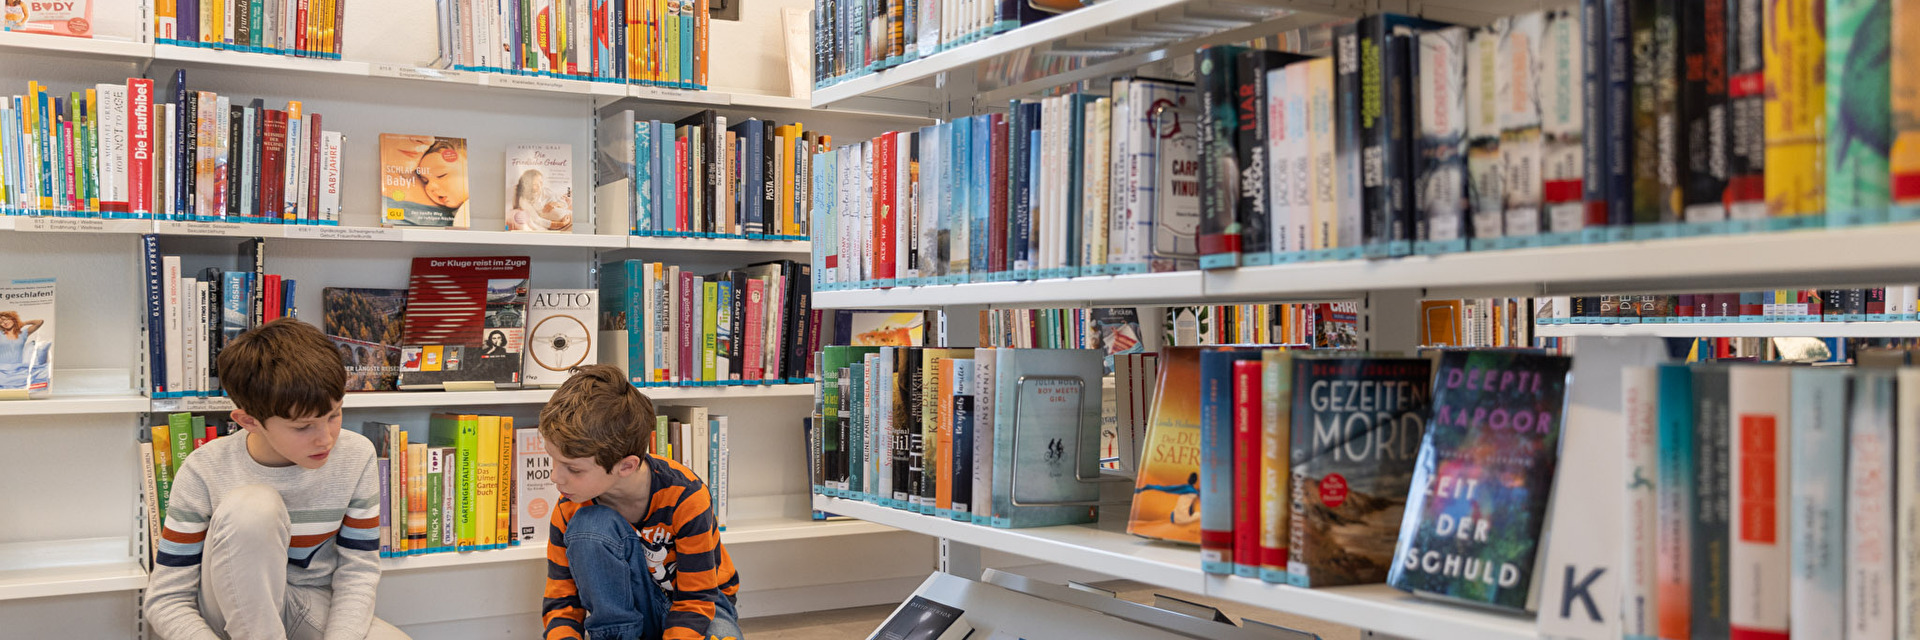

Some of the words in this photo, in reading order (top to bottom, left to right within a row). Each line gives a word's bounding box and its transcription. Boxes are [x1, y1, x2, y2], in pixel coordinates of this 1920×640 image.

[134, 83, 147, 139] Laufbibel
[1240, 84, 1256, 131] LIAR
[114, 128, 123, 150] NOT
[134, 141, 147, 160] Die
[386, 174, 416, 188] Baby!
[1172, 160, 1199, 176] CARP
[1242, 167, 1253, 197] LISA
[1252, 146, 1265, 214] JACKSON
[1171, 180, 1200, 196] VINU
[149, 236, 158, 276] EXPRESS
[446, 260, 471, 269] Kluge
[505, 260, 526, 268] Zuge
[5, 290, 54, 300] geschlafen!
[150, 279, 159, 317] GLACIER
[532, 292, 592, 308] AUTO
[1446, 368, 1542, 394] DEEPTI
[1310, 380, 1426, 412] GEZEITEN
[1436, 405, 1552, 434] KAPOOR
[1177, 431, 1200, 445] DU
[1312, 412, 1425, 462] MORD
[909, 433, 922, 471] Hill
[1153, 444, 1200, 465] SAFR
[501, 435, 510, 511] PFLANZENSCHNITT
[1423, 474, 1479, 500] ZEIT
[1436, 514, 1490, 542] DER
[1402, 546, 1521, 588] SCHULD
[1559, 564, 1608, 623] K
